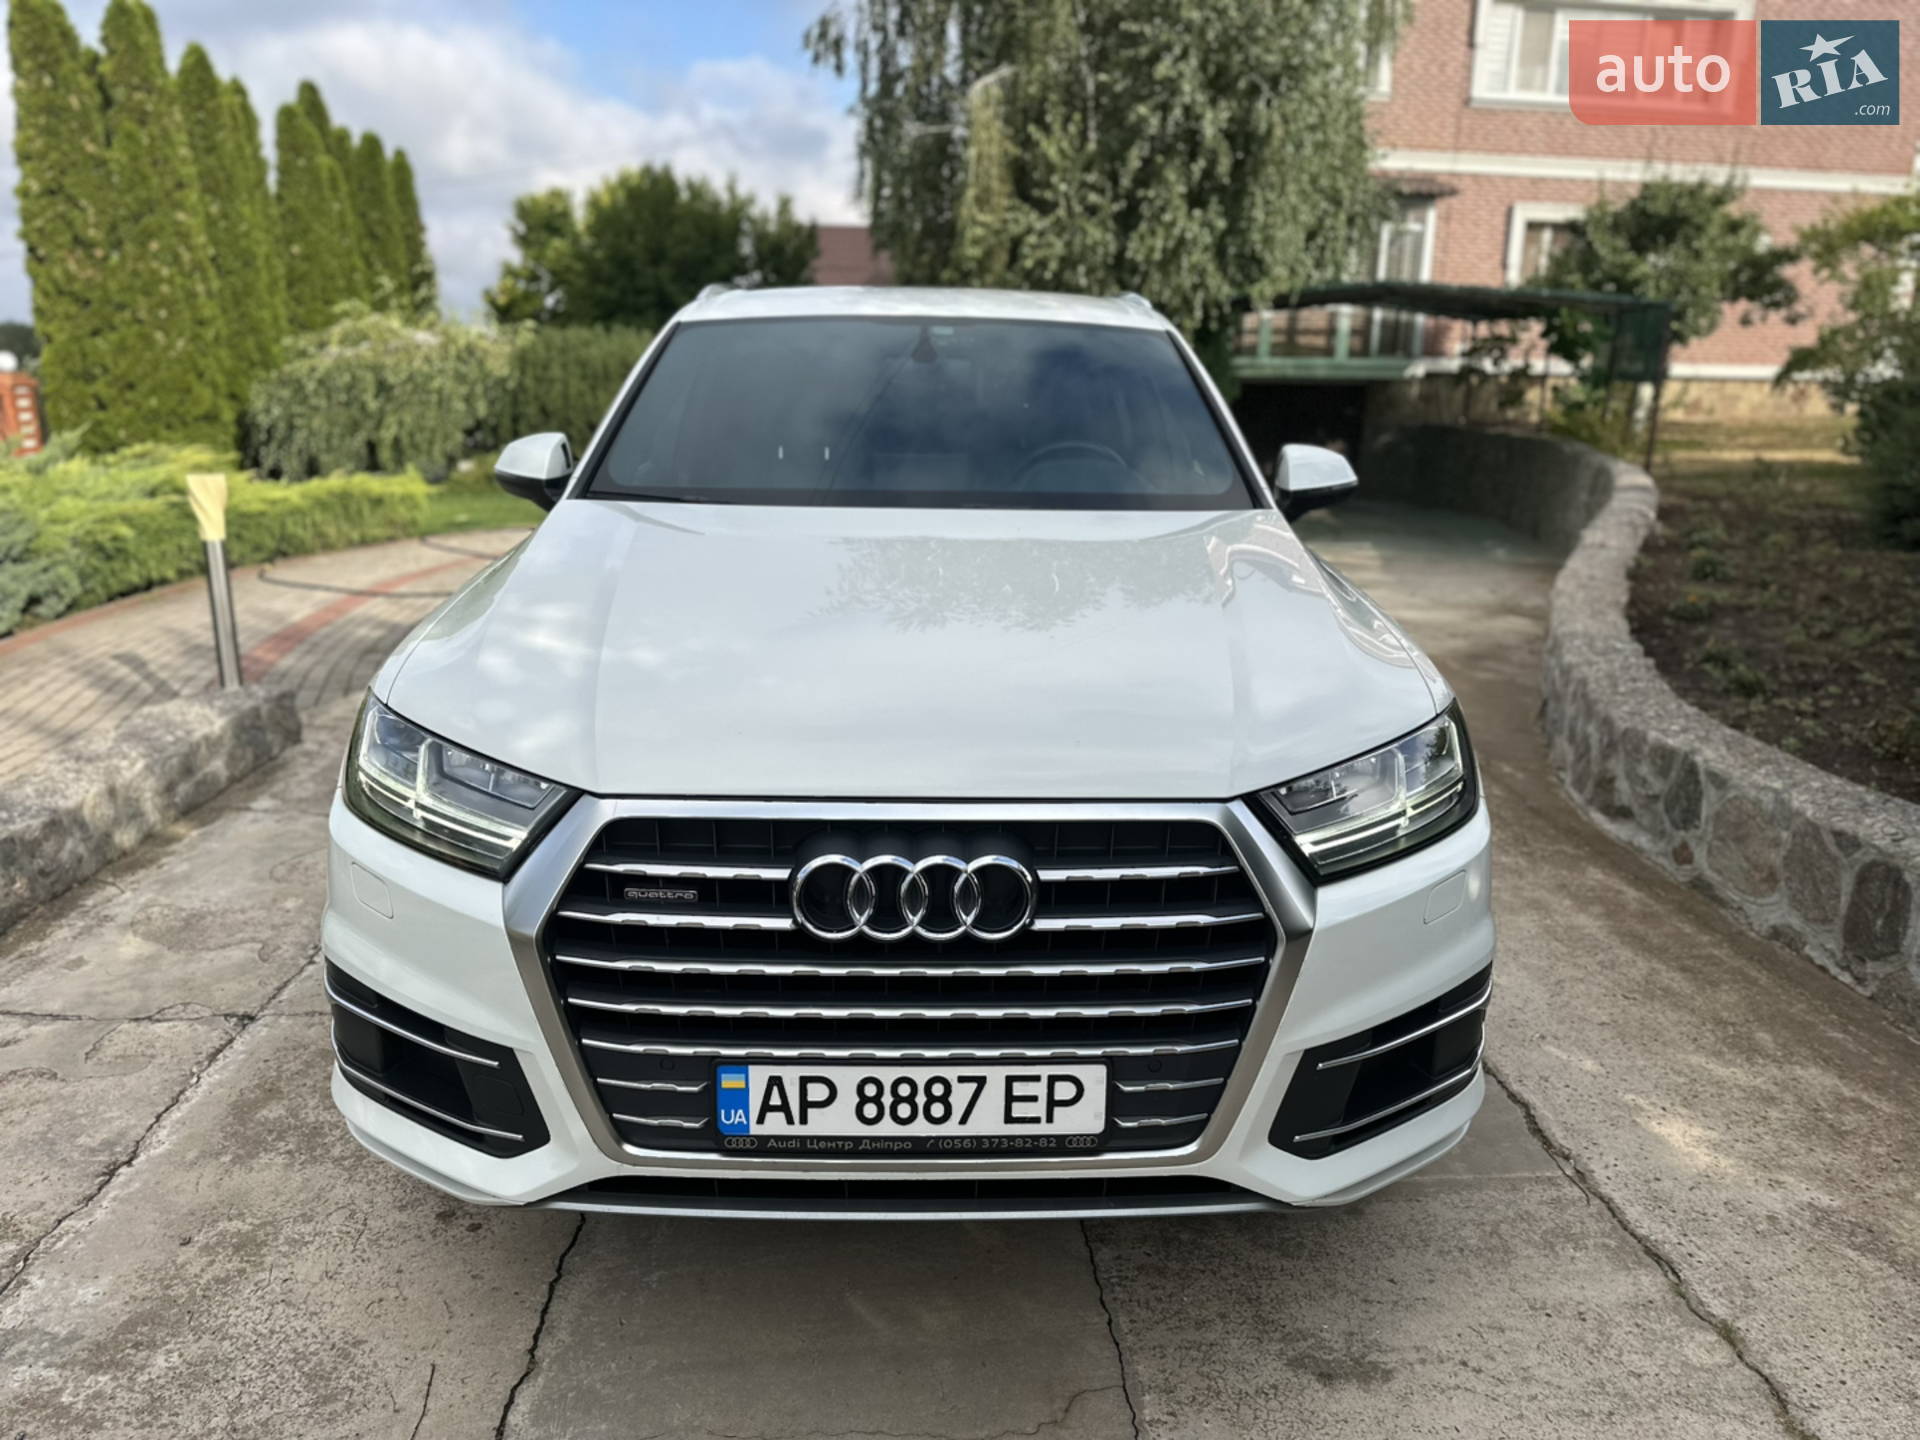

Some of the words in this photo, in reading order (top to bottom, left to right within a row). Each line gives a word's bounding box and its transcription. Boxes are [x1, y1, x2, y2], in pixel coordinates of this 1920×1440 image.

[627, 891, 695, 899] quattro
[755, 1075, 838, 1125] AP
[855, 1075, 988, 1126] 8887
[1003, 1074, 1085, 1125] EP
[720, 1109, 748, 1125] UA
[766, 1138, 800, 1148] Audi
[806, 1138, 854, 1150] Центр
[858, 1139, 912, 1150] Дніпро
[938, 1138, 977, 1149] (056)
[982, 1138, 1057, 1148] 373-82-82
